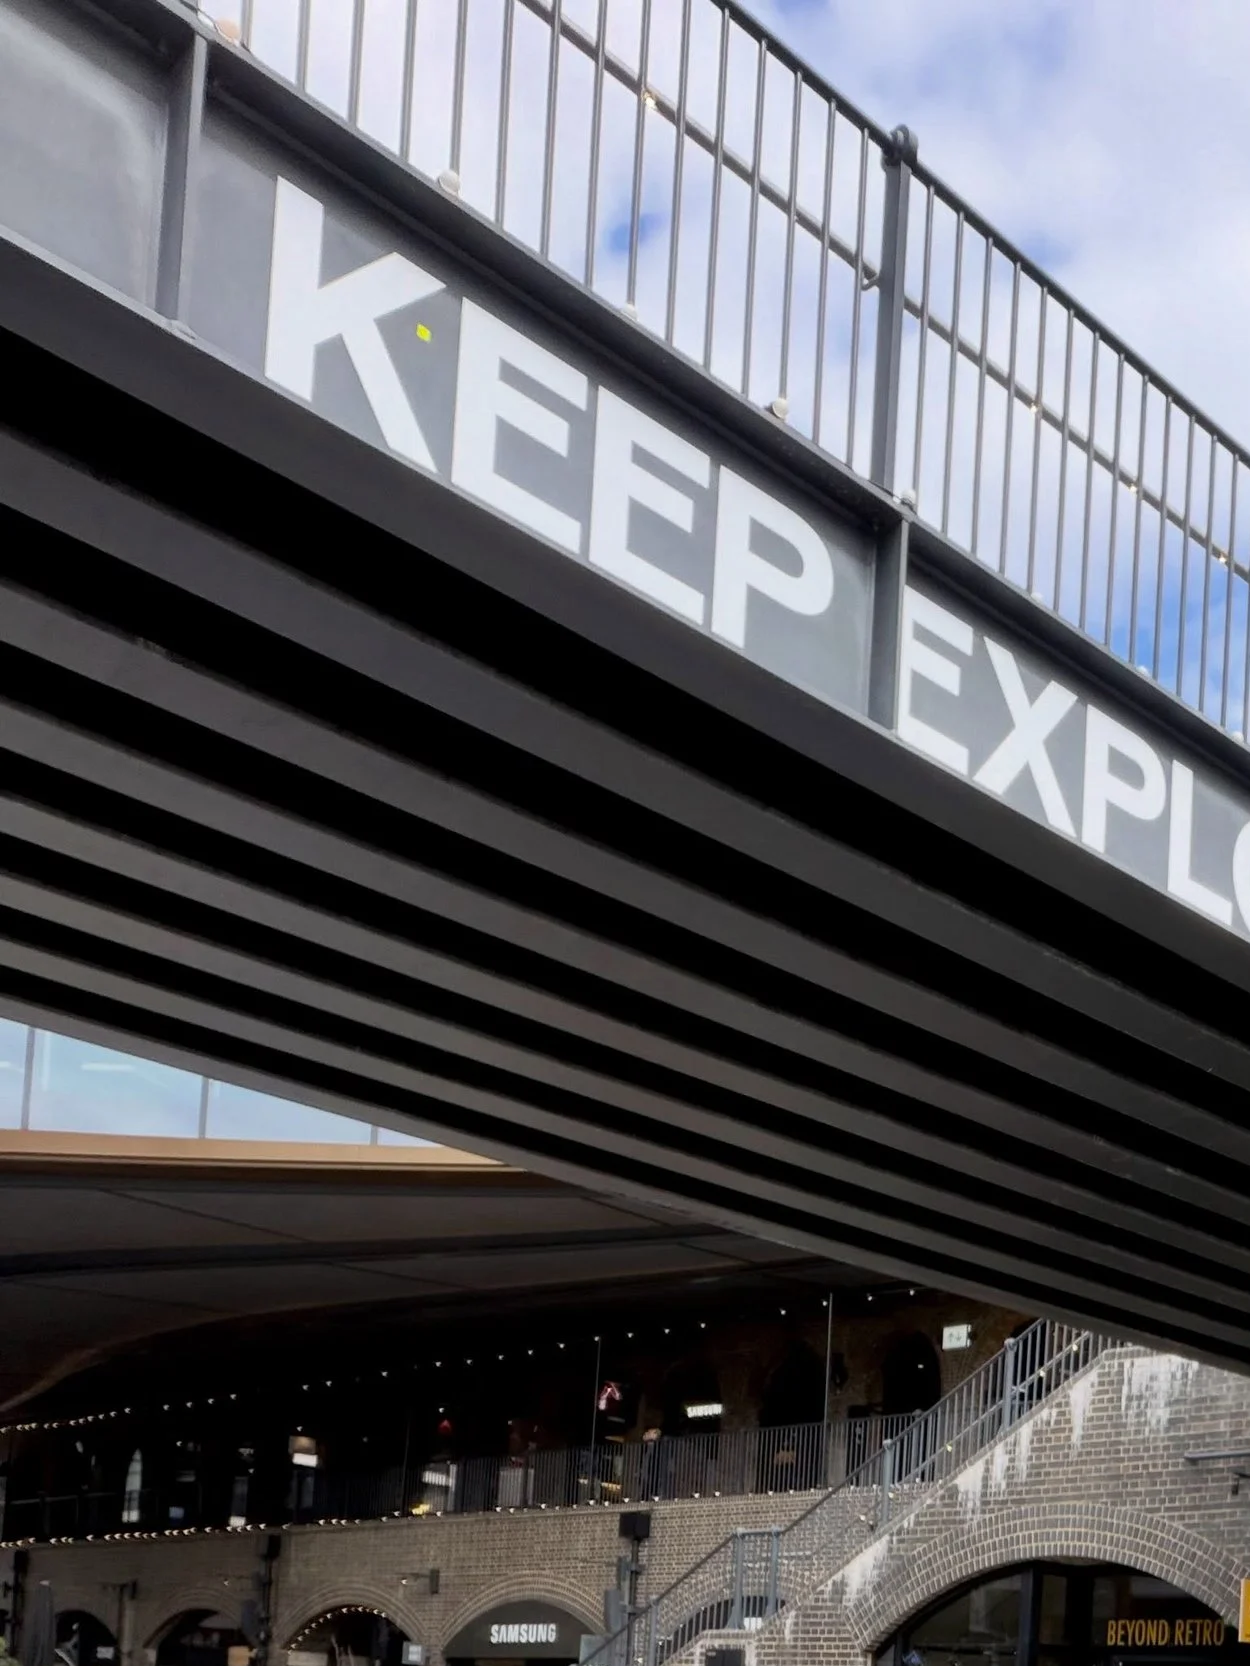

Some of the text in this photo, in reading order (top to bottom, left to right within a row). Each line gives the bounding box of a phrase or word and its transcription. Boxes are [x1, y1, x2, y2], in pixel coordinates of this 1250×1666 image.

[265, 176, 834, 650] KEEP
[490, 1623, 557, 1644] SAMSUNG
[1107, 1618, 1225, 1646] BEYOND RETRO
